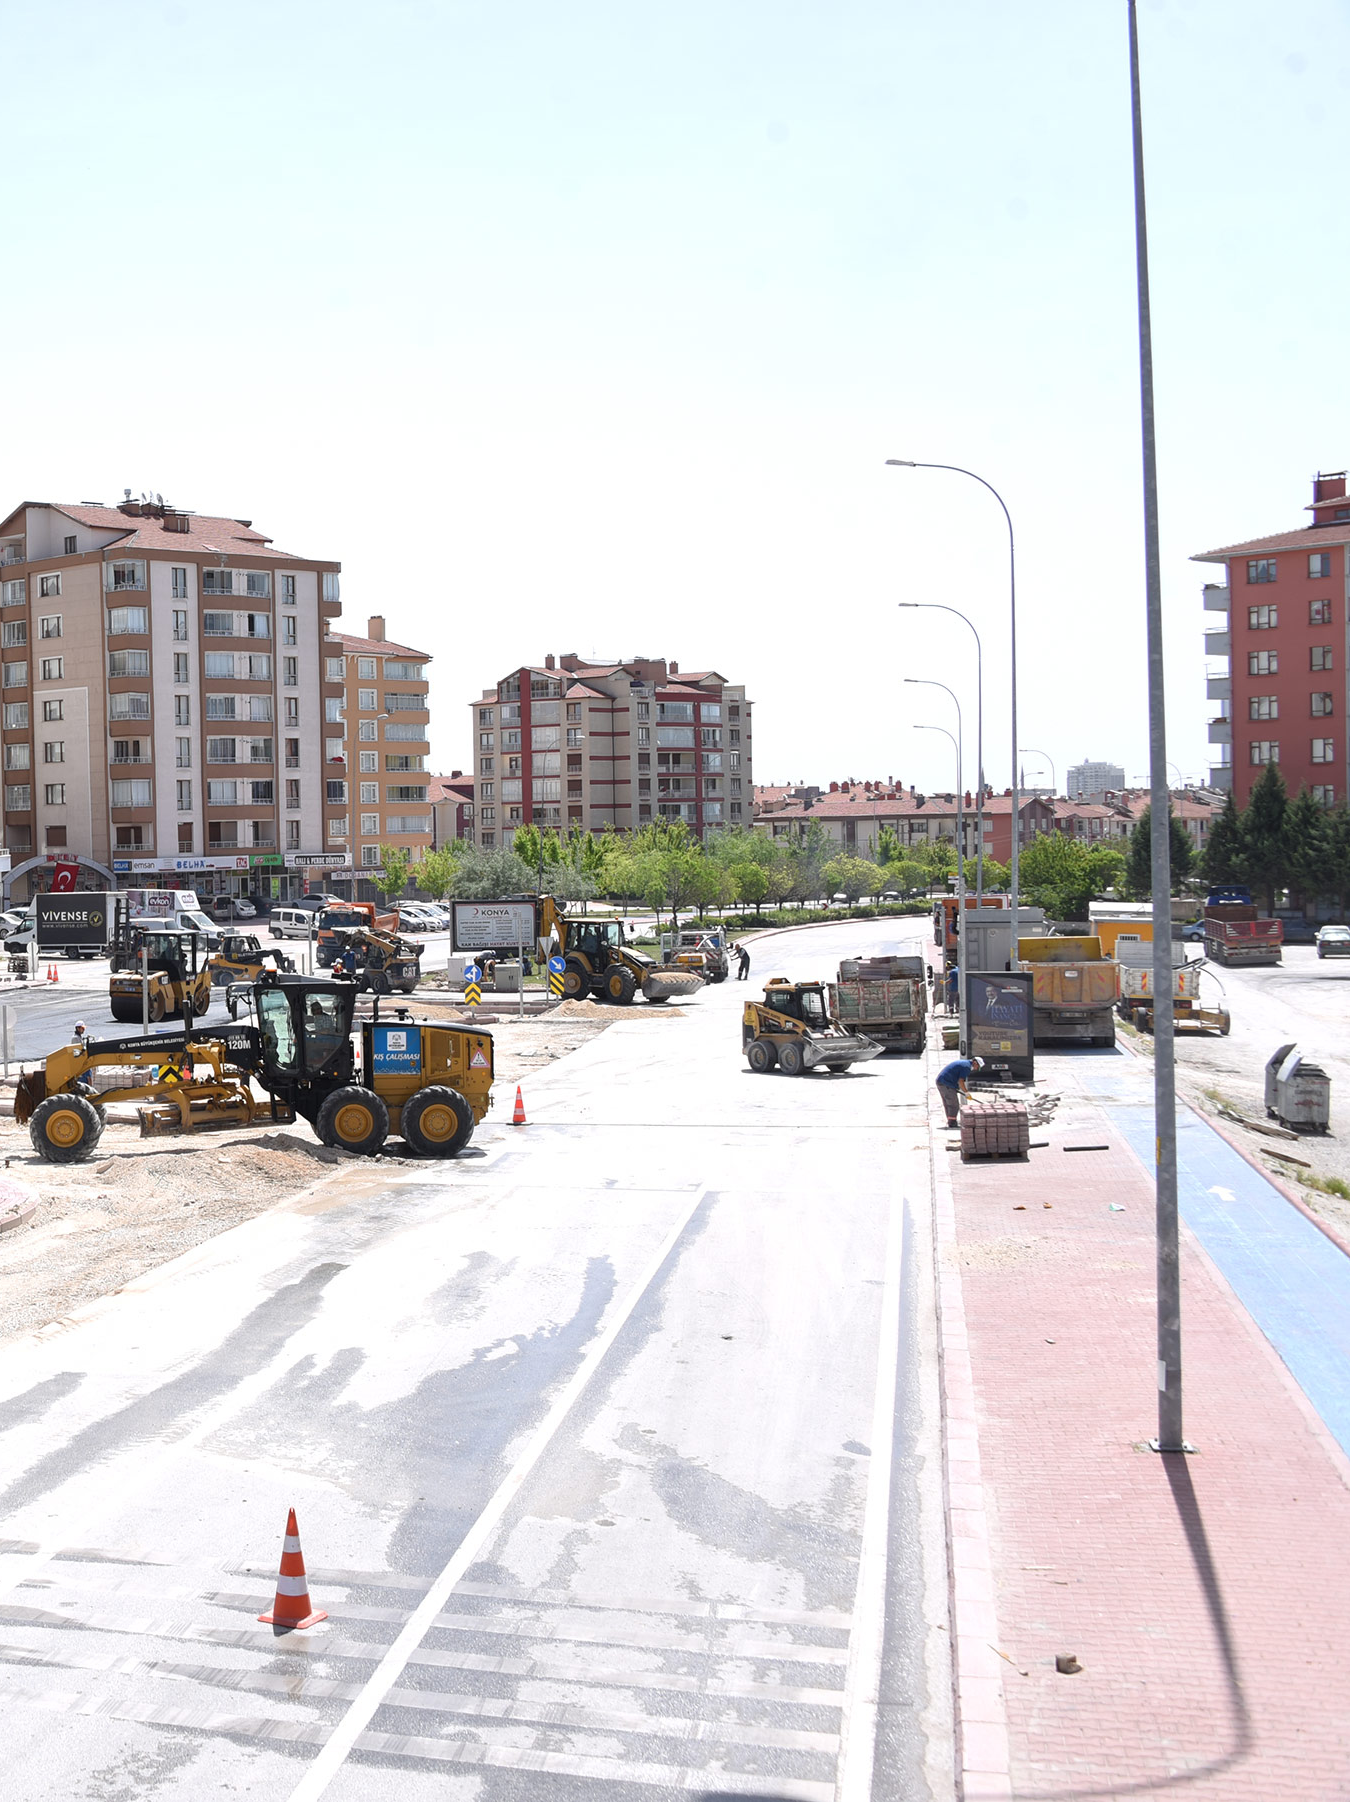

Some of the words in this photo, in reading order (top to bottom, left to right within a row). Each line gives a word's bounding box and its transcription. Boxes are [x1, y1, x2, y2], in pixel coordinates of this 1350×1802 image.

[176, 860, 205, 868] BELHA
[402, 966, 416, 977] CAT
[227, 1040, 250, 1050] 120M
[386, 1053, 420, 1061] ÇALIŞMASI
